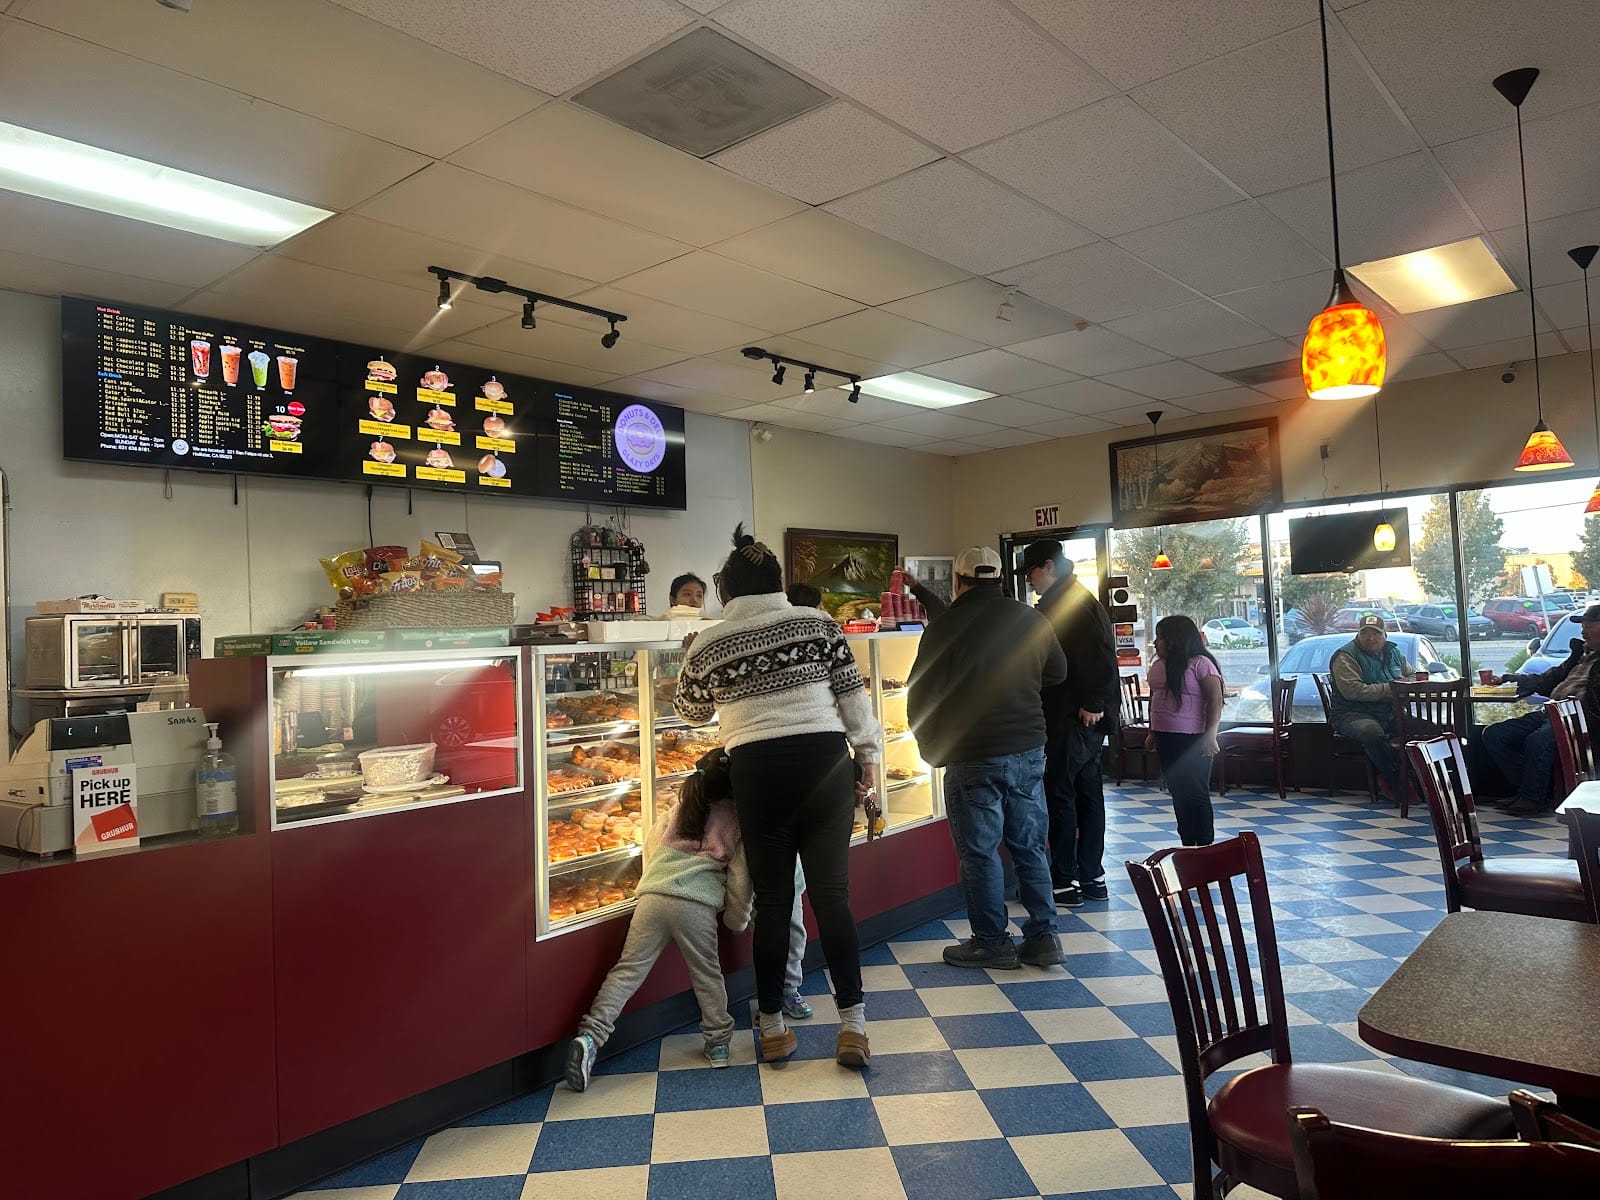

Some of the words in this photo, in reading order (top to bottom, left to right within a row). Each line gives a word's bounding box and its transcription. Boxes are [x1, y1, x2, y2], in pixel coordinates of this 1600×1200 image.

[619, 409, 644, 431] DONUTS
[622, 450, 642, 467] GLAZY
[645, 454, 660, 468] DAYS
[1035, 506, 1058, 527] EXIT
[80, 779, 110, 791] Pick
[113, 779, 130, 789] up
[80, 790, 131, 808] HERE
[101, 823, 134, 840] GRUBHUB
